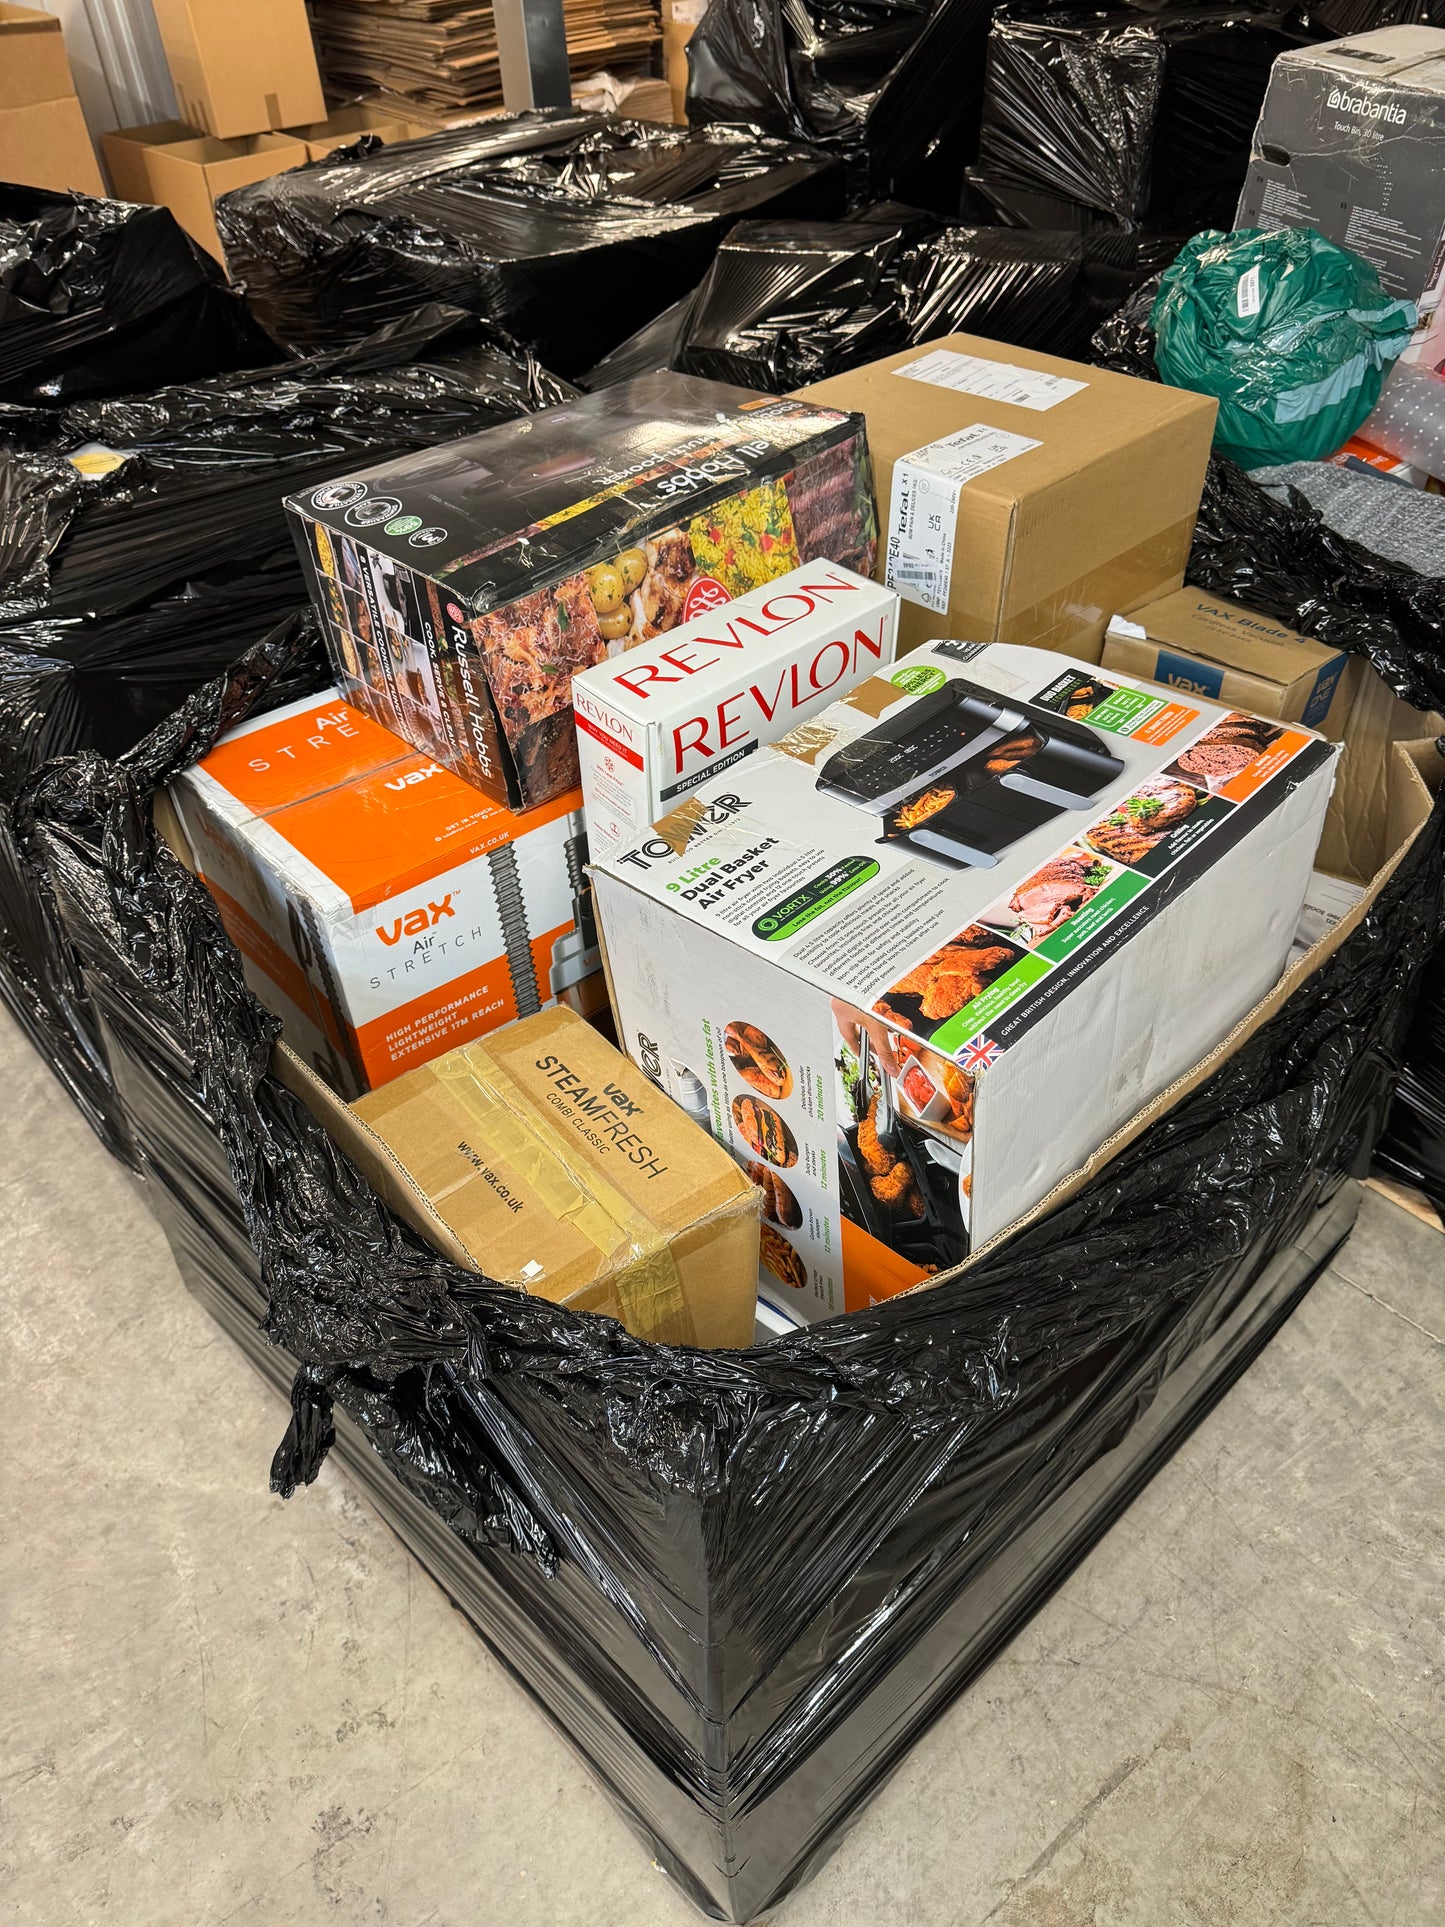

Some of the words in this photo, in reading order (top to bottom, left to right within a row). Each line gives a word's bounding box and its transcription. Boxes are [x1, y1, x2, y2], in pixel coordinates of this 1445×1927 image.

[1340, 91, 1407, 124] brabantia
[1334, 121, 1350, 133] Touch
[1351, 126, 1362, 137] Bin,
[1363, 129, 1371, 138] 30
[657, 454, 745, 494] Hobbs
[898, 489, 910, 535] Tefal
[928, 513, 936, 530] UK
[934, 514, 942, 532] CA
[362, 567, 382, 629] VERSATILE
[376, 630, 394, 682] COOKING
[612, 573, 860, 699] REVLON
[1192, 613, 1236, 632] Cordless
[1196, 603, 1236, 620] VAX
[1238, 618, 1287, 639] Blade
[425, 621, 437, 659] COOK,
[432, 661, 446, 693] SERVE
[444, 711, 457, 748] CLEAN
[452, 626, 480, 708] Russell
[471, 711, 492, 779] Hobbs
[672, 616, 884, 774] REVLON
[1040, 689, 1056, 702] DUO
[1053, 675, 1076, 694] BASKET
[1168, 673, 1208, 694] vax
[315, 710, 349, 731] Air
[576, 693, 633, 743] REVLON
[248, 723, 361, 772] STRE
[384, 763, 444, 791] vax
[677, 766, 712, 793] SPECIAL
[713, 749, 746, 776] EDITION
[445, 821, 460, 831] GET
[461, 817, 469, 825] IN
[470, 807, 494, 821] TOUCH
[617, 793, 752, 870] TOWER
[469, 831, 511, 854] VAX.CO.UK
[666, 882, 681, 893] 9
[678, 857, 721, 884] Litre
[680, 872, 723, 901] Dual
[720, 836, 779, 875] Basket
[698, 887, 725, 910] Air
[722, 860, 770, 891] Fryer
[824, 867, 843, 879] 30%
[376, 893, 456, 946] vax
[773, 894, 810, 920] VORTX
[791, 916, 806, 926] Lose
[803, 910, 816, 918] the
[813, 903, 826, 911] fat,
[831, 890, 843, 898] the
[840, 876, 863, 892] flavour!
[371, 926, 483, 989] STRETCH
[413, 935, 435, 955] Air
[1001, 1016, 1022, 1036] GREAT
[1020, 996, 1046, 1018] BRITISH
[1044, 976, 1070, 998] DESIGN,
[1067, 945, 1104, 978] INNOVATION
[1102, 934, 1116, 948] AND
[1114, 905, 1150, 937] EXCELLENCE
[385, 1024, 411, 1042] HIGH
[415, 985, 489, 1028] PERFORMANCE
[388, 1011, 458, 1052] LIGHTWEIGHT
[391, 1027, 448, 1061] EXTENSIVE
[451, 1018, 469, 1031] 17M
[472, 999, 505, 1020] REACH
[702, 1018, 711, 1035] fat
[705, 1037, 714, 1059] less
[707, 1061, 718, 1088] with
[816, 1075, 824, 1110] minutes
[535, 1055, 669, 1180] STEAMFRESH
[602, 1082, 641, 1117] vax
[710, 1089, 724, 1141] favourites
[817, 1111, 824, 1122] 20
[546, 1092, 573, 1124] COMBI
[572, 1118, 610, 1155] CLASSIC
[457, 1140, 525, 1214] www.vax.co.uk
